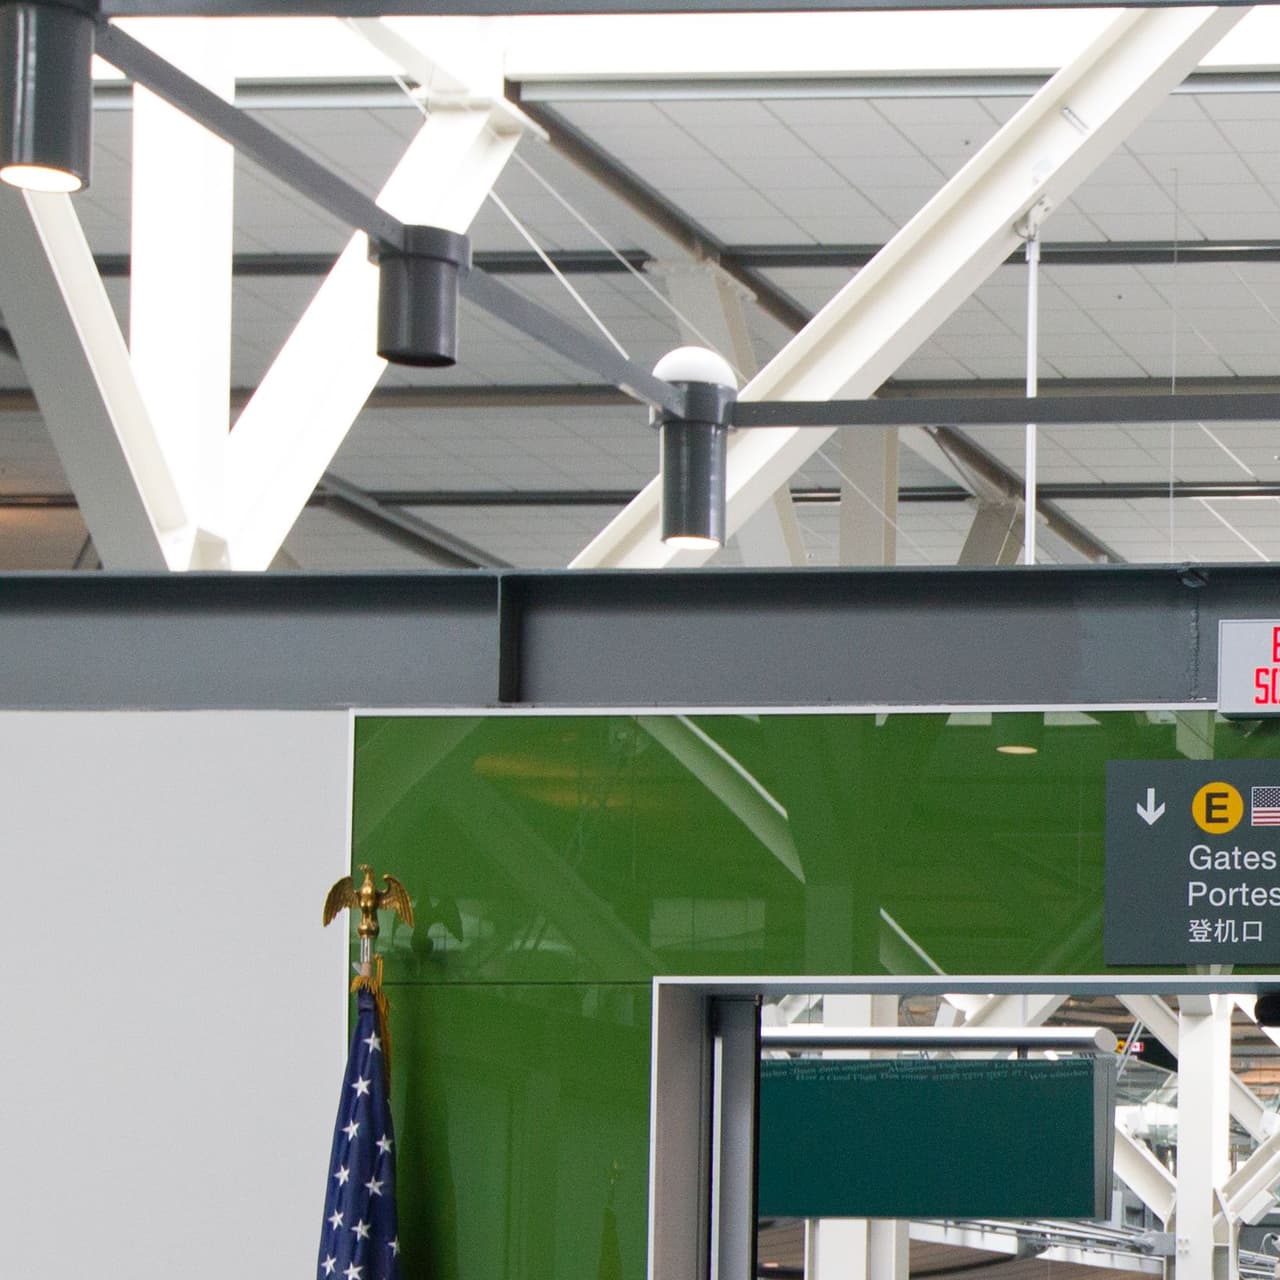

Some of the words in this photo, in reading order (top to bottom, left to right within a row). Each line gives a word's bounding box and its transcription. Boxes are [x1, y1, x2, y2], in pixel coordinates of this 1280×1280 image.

[1204, 792, 1230, 824] E
[1188, 844, 1278, 872] Gates
[1188, 918, 1264, 945] 登机口
